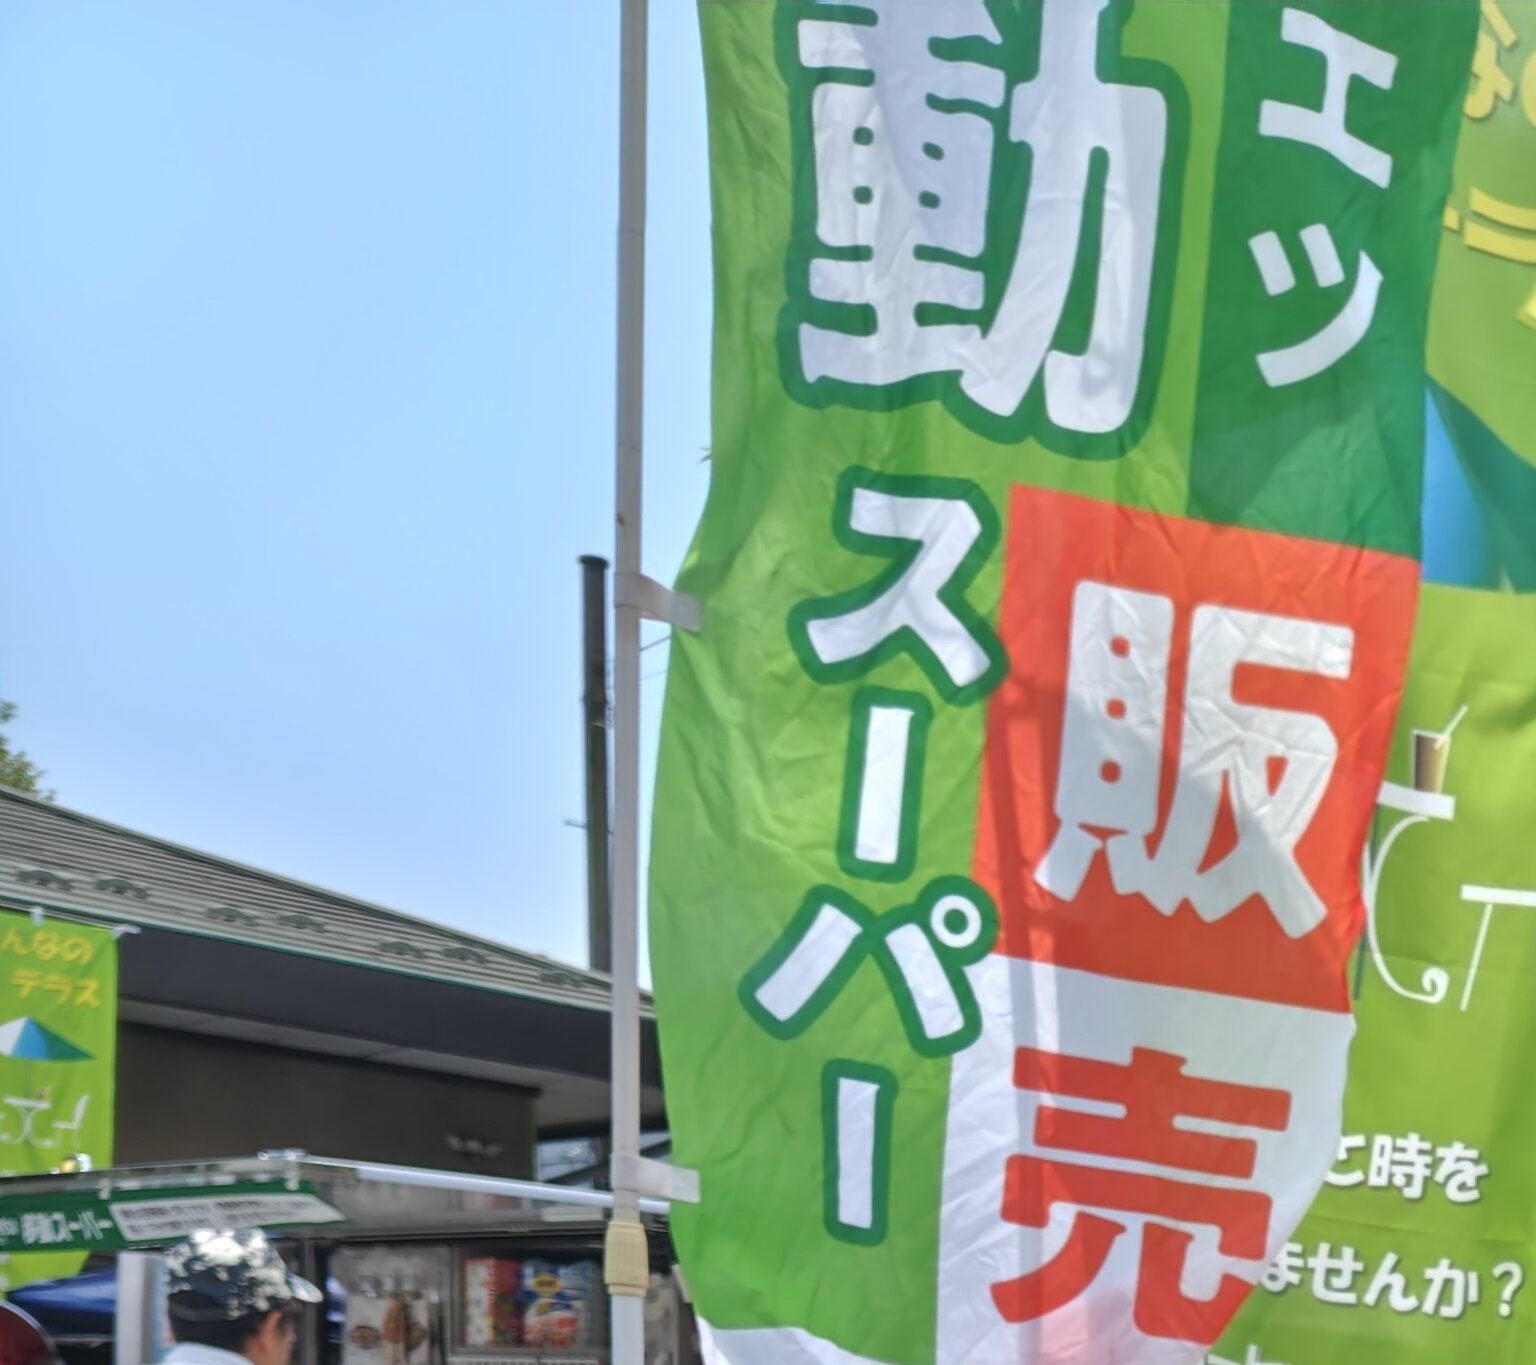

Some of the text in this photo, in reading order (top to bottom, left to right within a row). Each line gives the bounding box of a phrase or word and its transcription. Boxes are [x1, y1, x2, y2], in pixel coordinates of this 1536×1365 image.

[11, 969, 101, 1009] テラス
[754, 486, 991, 1230] スーパー
